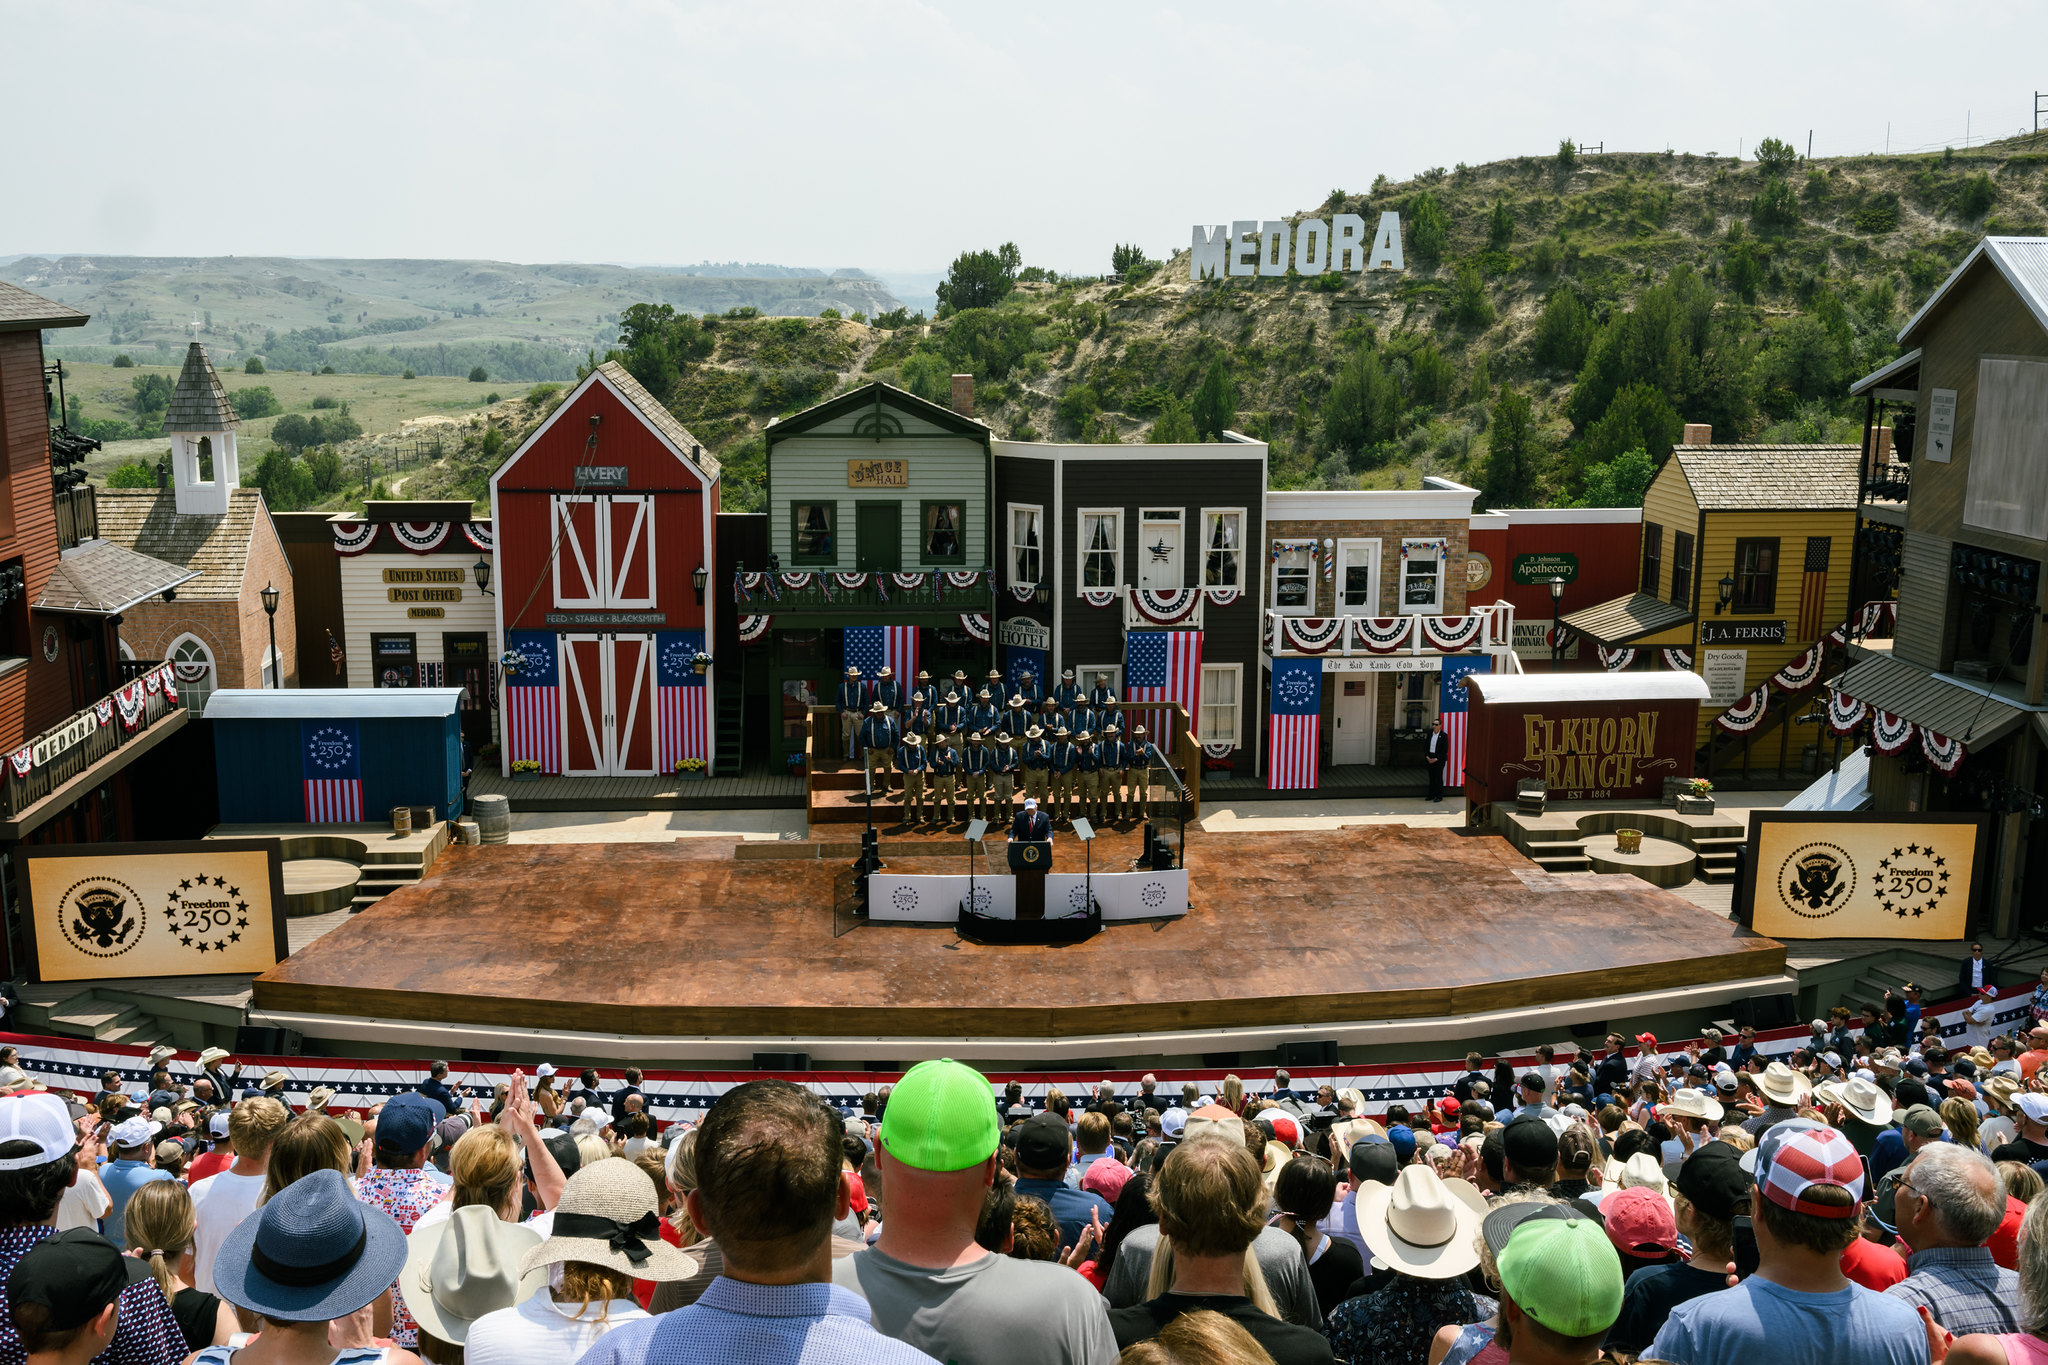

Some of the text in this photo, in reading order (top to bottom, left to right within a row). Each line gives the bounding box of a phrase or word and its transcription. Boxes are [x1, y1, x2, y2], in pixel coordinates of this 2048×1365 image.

[1190, 211, 1404, 281] MEDORA
[577, 466, 625, 480] LIVERY
[854, 461, 902, 482] DANCE
[877, 475, 906, 485] HALL
[388, 569, 459, 582] UNITED STATES
[1518, 563, 1574, 576] Apothecary
[393, 588, 455, 601] POST OFFICE
[411, 608, 441, 617] MEDORA
[546, 614, 665, 623] FEED STABLE BLACKSMITH
[1002, 623, 1048, 636] ROUGH RIDERS
[1705, 627, 1781, 642] J. A. FERRIS
[1000, 629, 1048, 649] HOTEL
[1707, 652, 1744, 661] Dry Goods,
[1327, 659, 1434, 669] The Bad Lands Cow Boy
[1286, 685, 1308, 697] 250
[38, 716, 94, 764] MEDORA
[1523, 711, 1659, 761] ELKHORN
[319, 745, 344, 758] 250
[1545, 754, 1634, 789] RANCH
[1567, 790, 1611, 799] EST 1884
[1889, 867, 1933, 877] Freedom
[1888, 877, 1933, 899] 250
[181, 898, 230, 910] Freedom
[898, 897, 914, 905] 250
[1146, 893, 1161, 902] 250
[183, 908, 231, 933] 250
